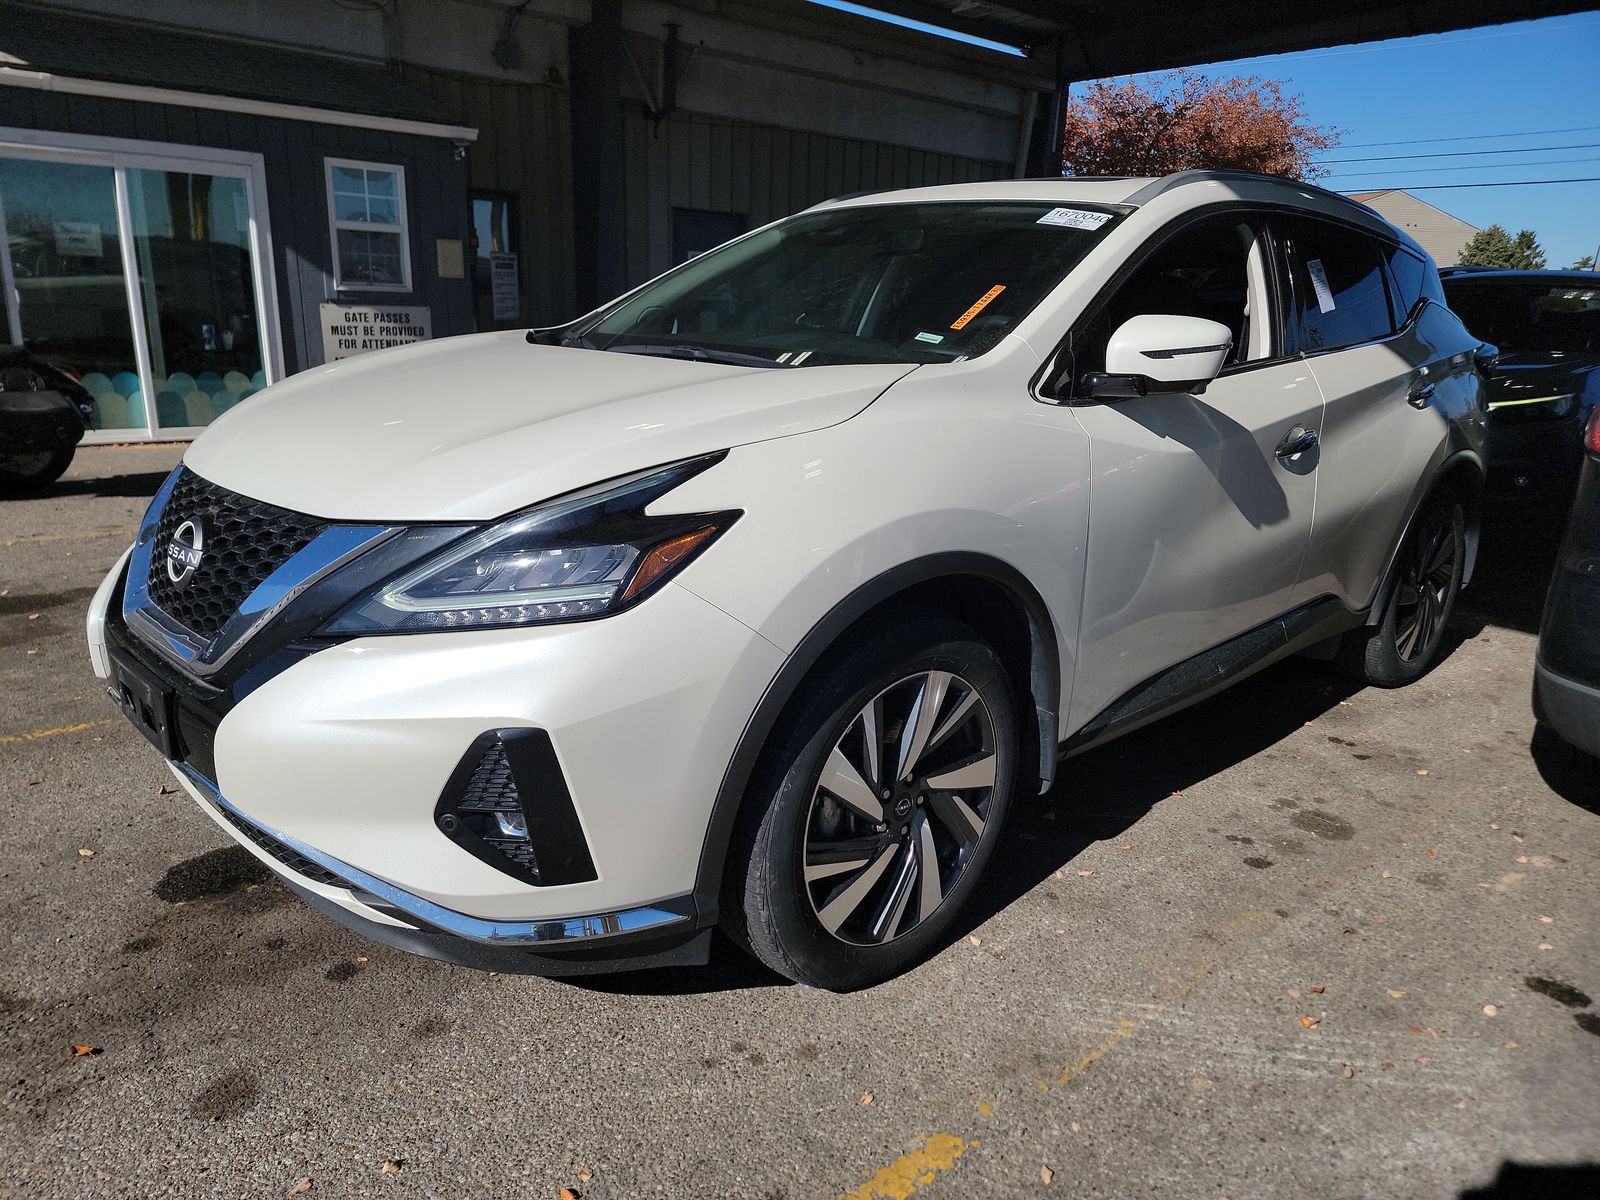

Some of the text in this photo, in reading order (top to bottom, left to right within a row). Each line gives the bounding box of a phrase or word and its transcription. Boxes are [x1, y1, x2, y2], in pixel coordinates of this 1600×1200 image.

[344, 312, 411, 324] GATE PASSES
[330, 325, 425, 337] MUST BE PROVIDED
[338, 339, 417, 350] FOR ATTENDA
